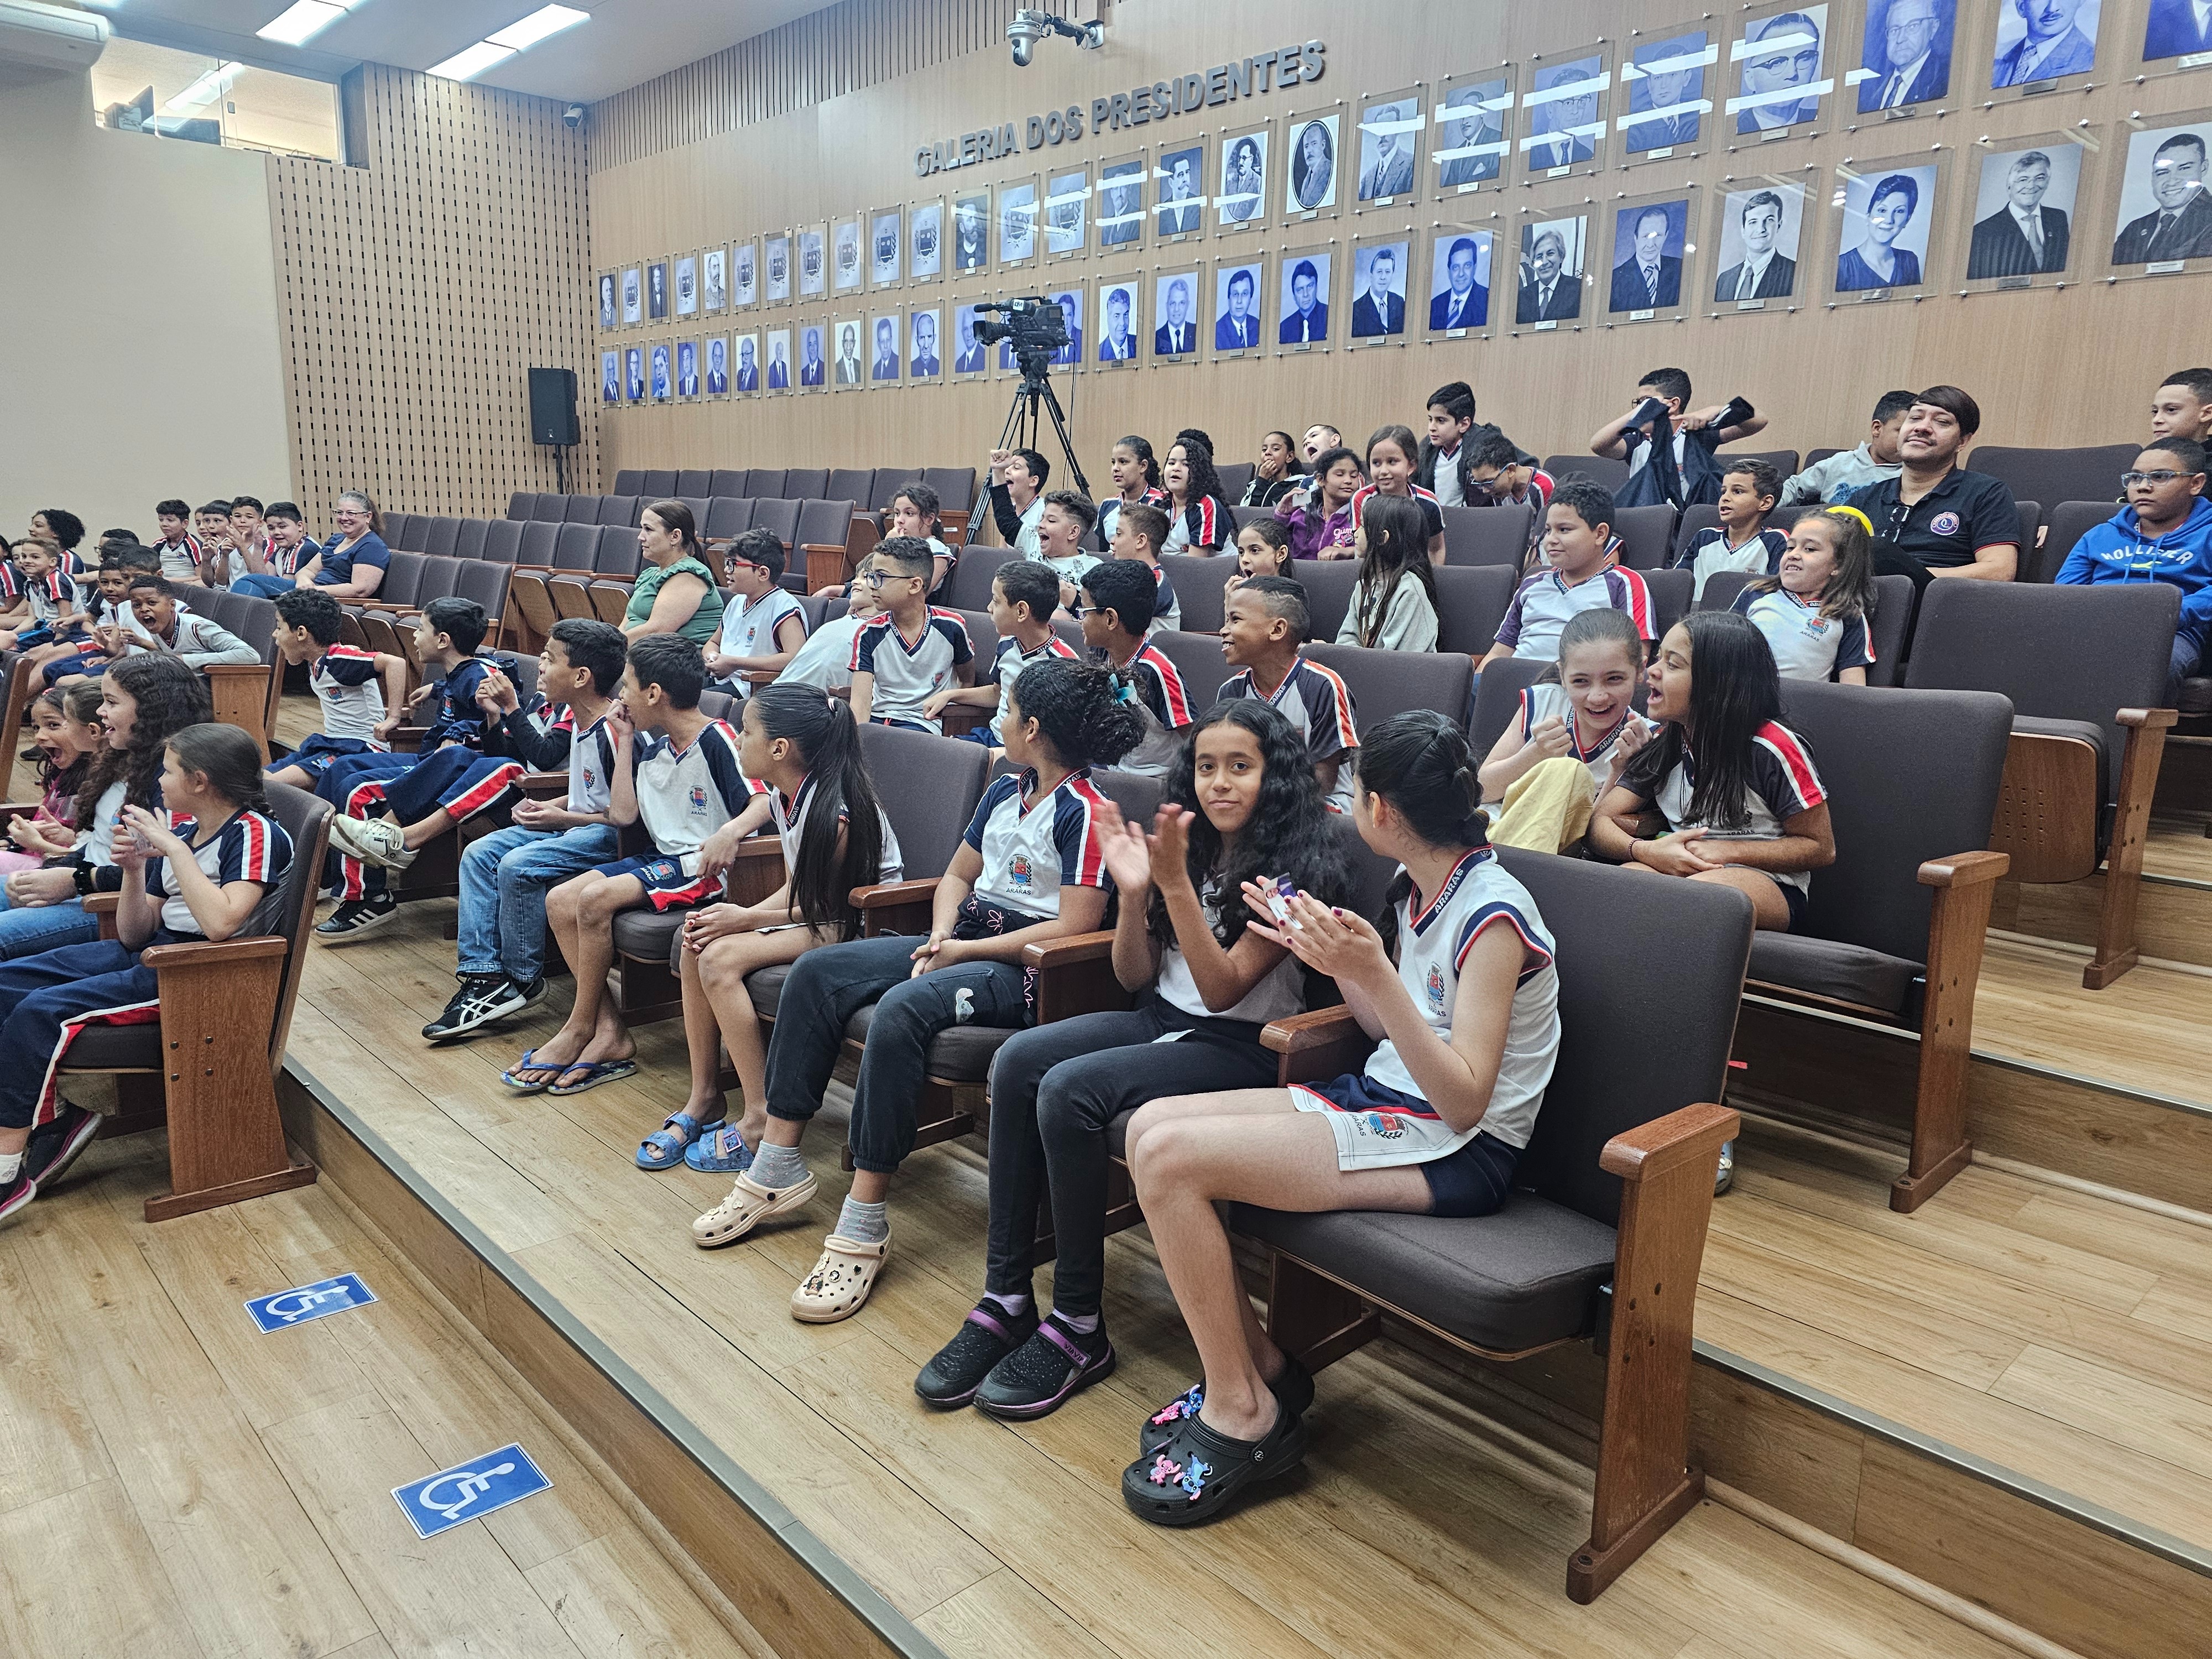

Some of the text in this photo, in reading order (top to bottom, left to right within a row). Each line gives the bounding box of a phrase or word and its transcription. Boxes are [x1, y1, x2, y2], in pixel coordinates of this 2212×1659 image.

[914, 39, 1326, 178] GALERIA DOS PRESIDENTES
[1799, 630, 1820, 642] ARARAS
[1599, 724, 1624, 752] ARARAS
[1005, 888, 1032, 896] ARARAS
[1434, 868, 1464, 915] ARARAS
